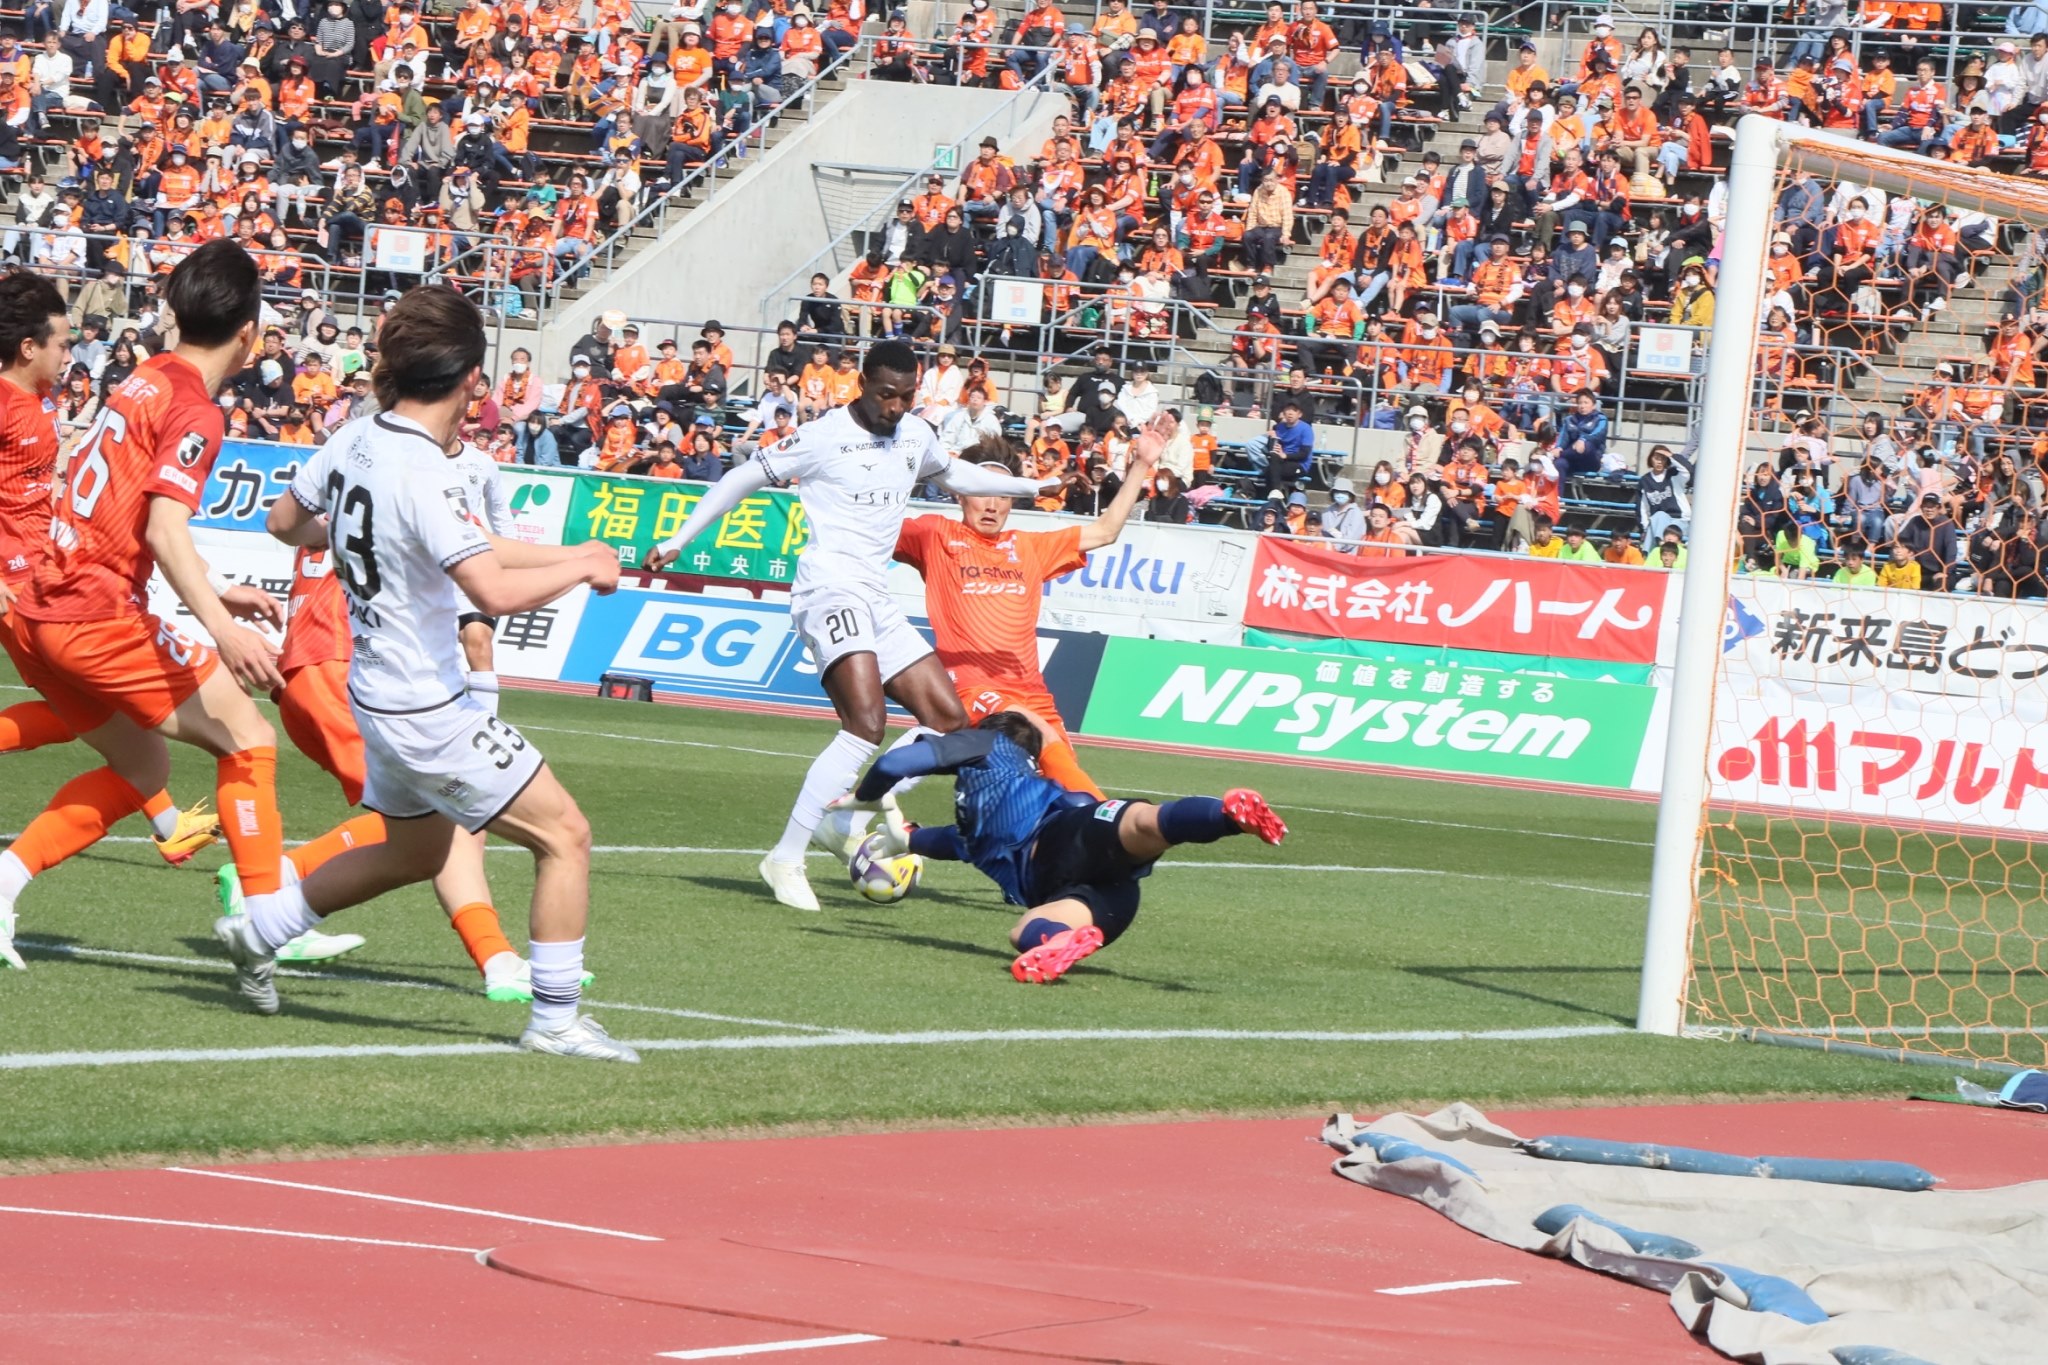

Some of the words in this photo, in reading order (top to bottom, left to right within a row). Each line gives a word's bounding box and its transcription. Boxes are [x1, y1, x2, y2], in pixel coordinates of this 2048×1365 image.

[856, 441, 886, 451] KATAGIRI
[618, 545, 788, 579] 四中央市
[1064, 590, 1098, 601] TRINITY
[1101, 594, 1141, 605] HOUSING
[1144, 598, 1177, 608] SQUARE
[639, 612, 763, 668] BG
[826, 607, 860, 645] 20
[1315, 660, 1555, 703] 価値を創造する
[1139, 664, 1592, 759] NPsystem
[471, 715, 525, 771] 33
